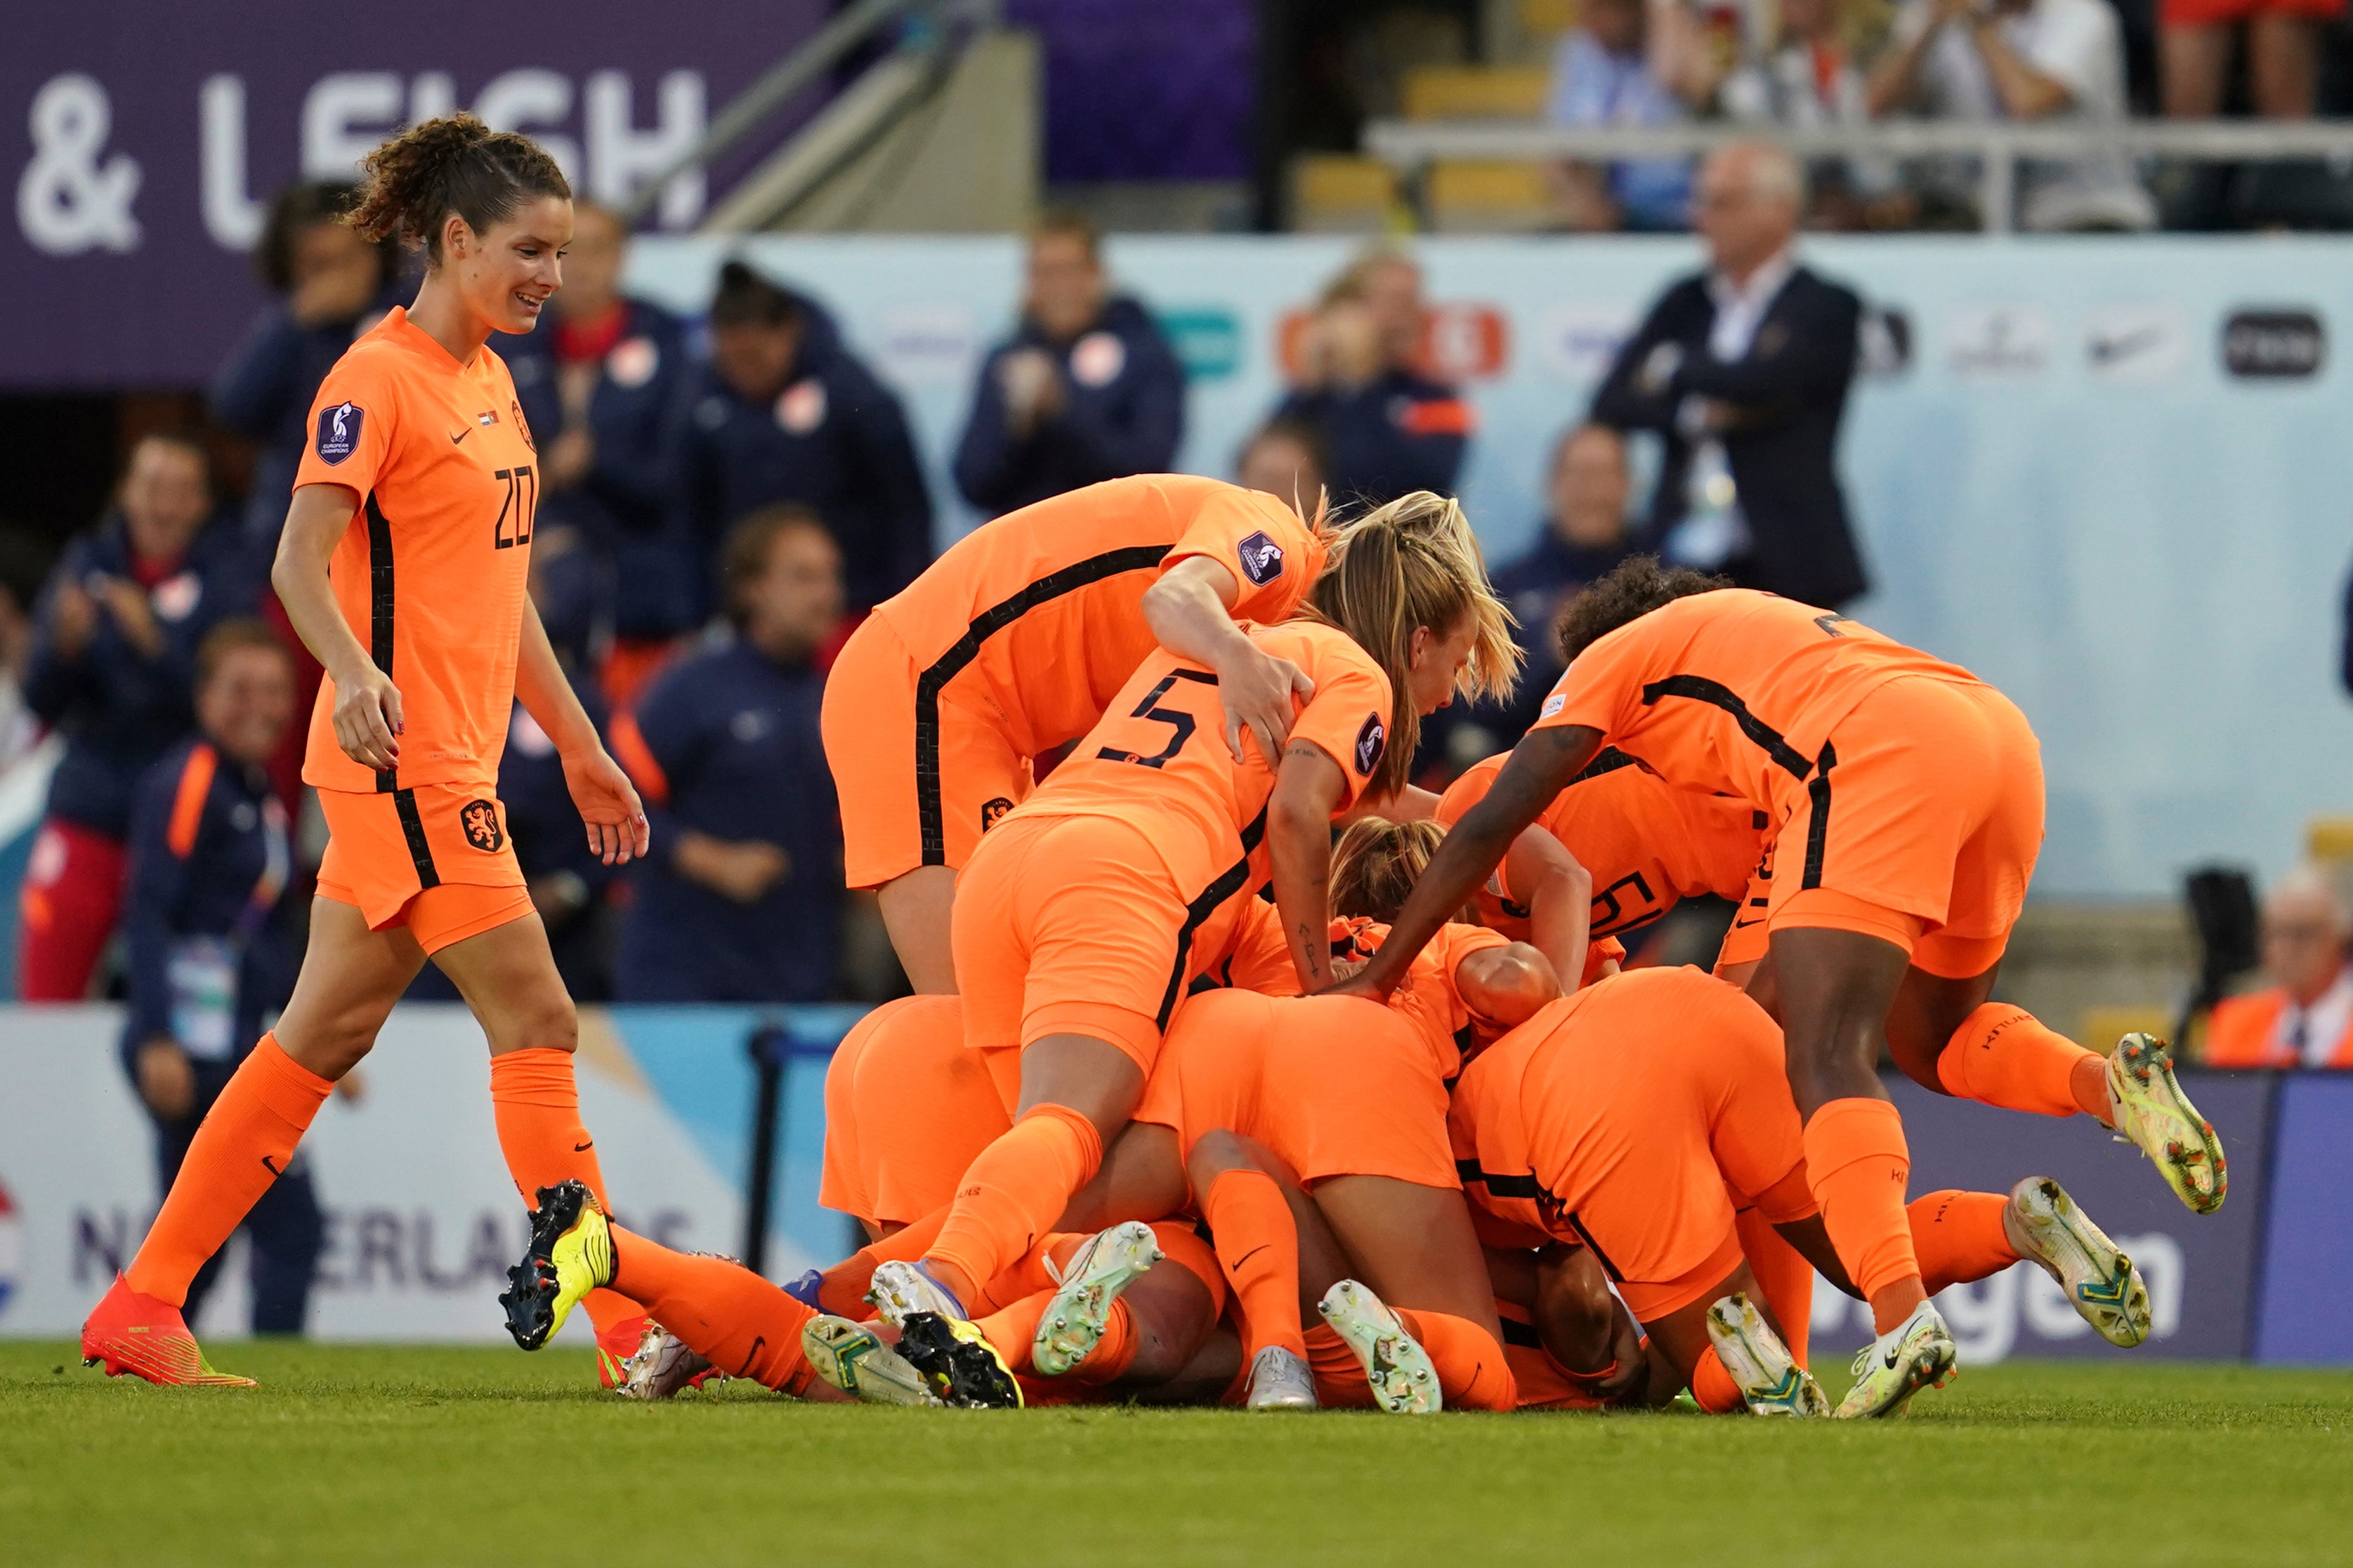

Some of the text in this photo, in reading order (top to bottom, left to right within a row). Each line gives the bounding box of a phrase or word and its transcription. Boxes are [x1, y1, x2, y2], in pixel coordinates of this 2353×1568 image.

[15, 72, 145, 256] &
[494, 465, 534, 550] 20
[1096, 668, 1219, 768] 5
